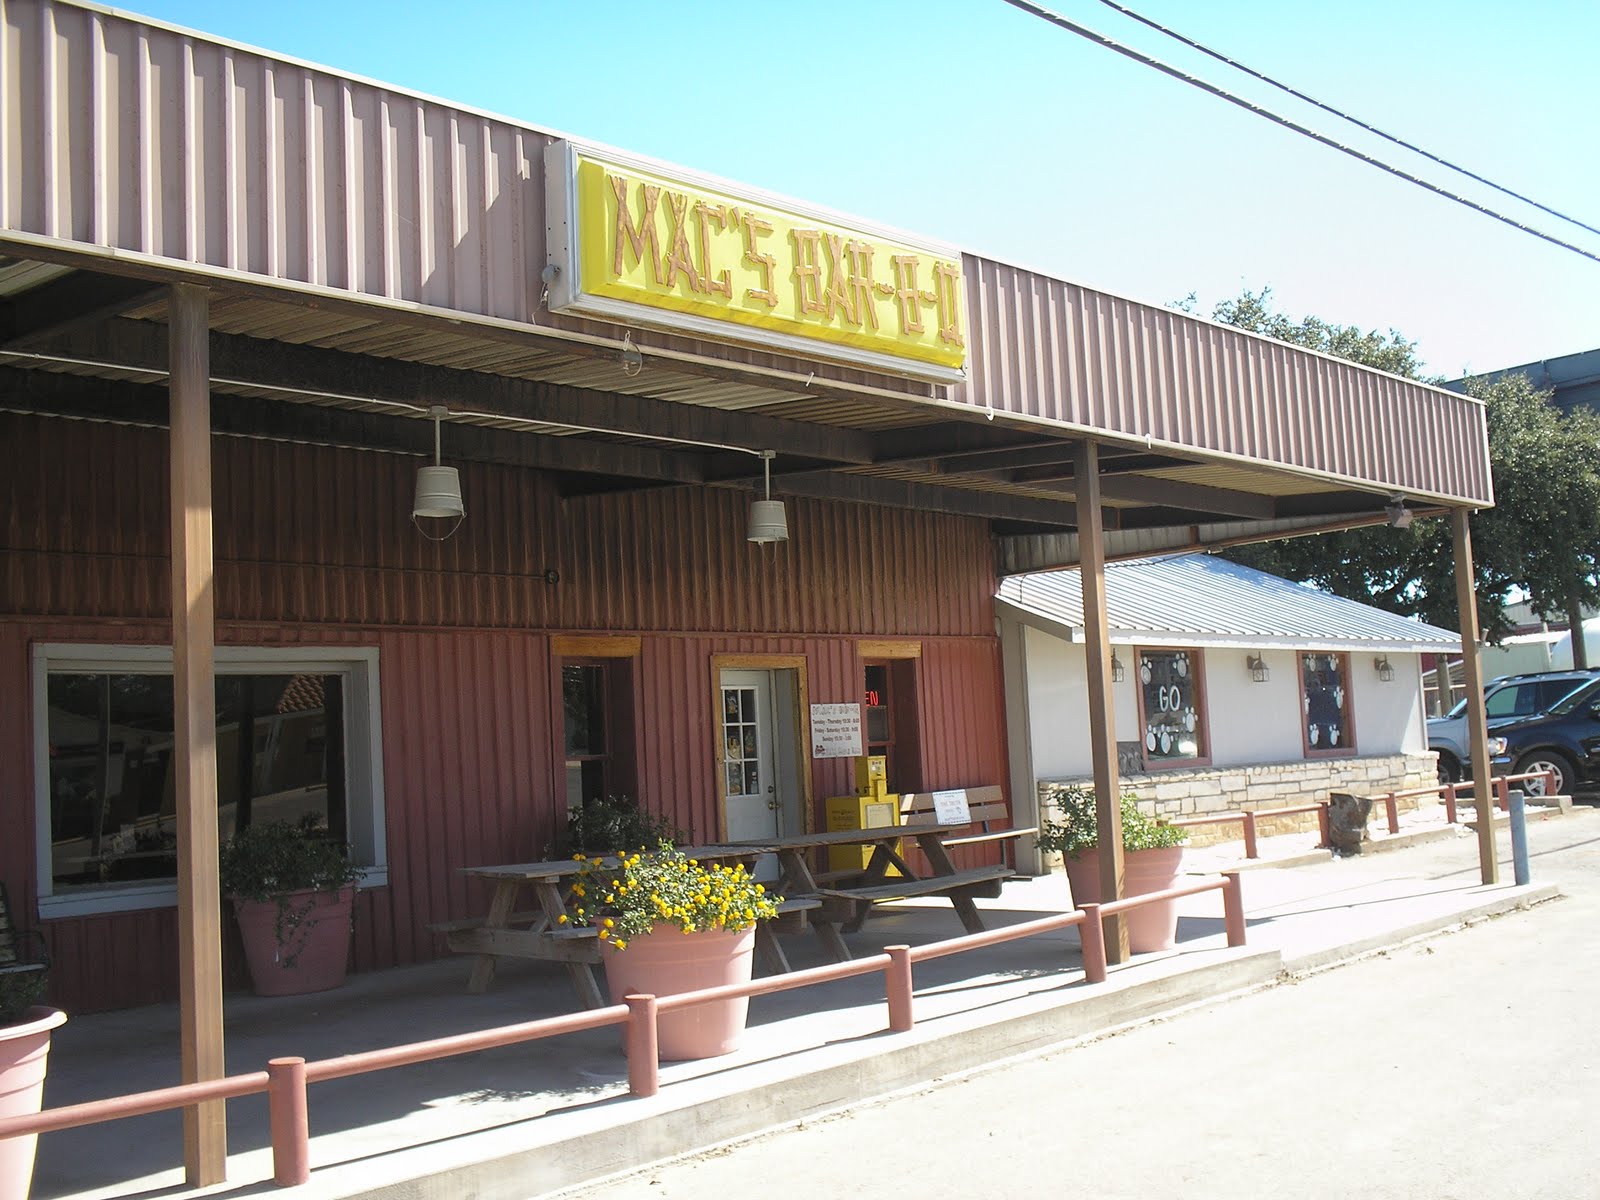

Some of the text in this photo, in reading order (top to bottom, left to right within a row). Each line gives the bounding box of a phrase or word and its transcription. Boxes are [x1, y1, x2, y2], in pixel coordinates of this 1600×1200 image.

[609, 175, 965, 347] MAC'S BAR-B-Q
[865, 690, 879, 706] EN
[1160, 685, 1181, 712] GO
